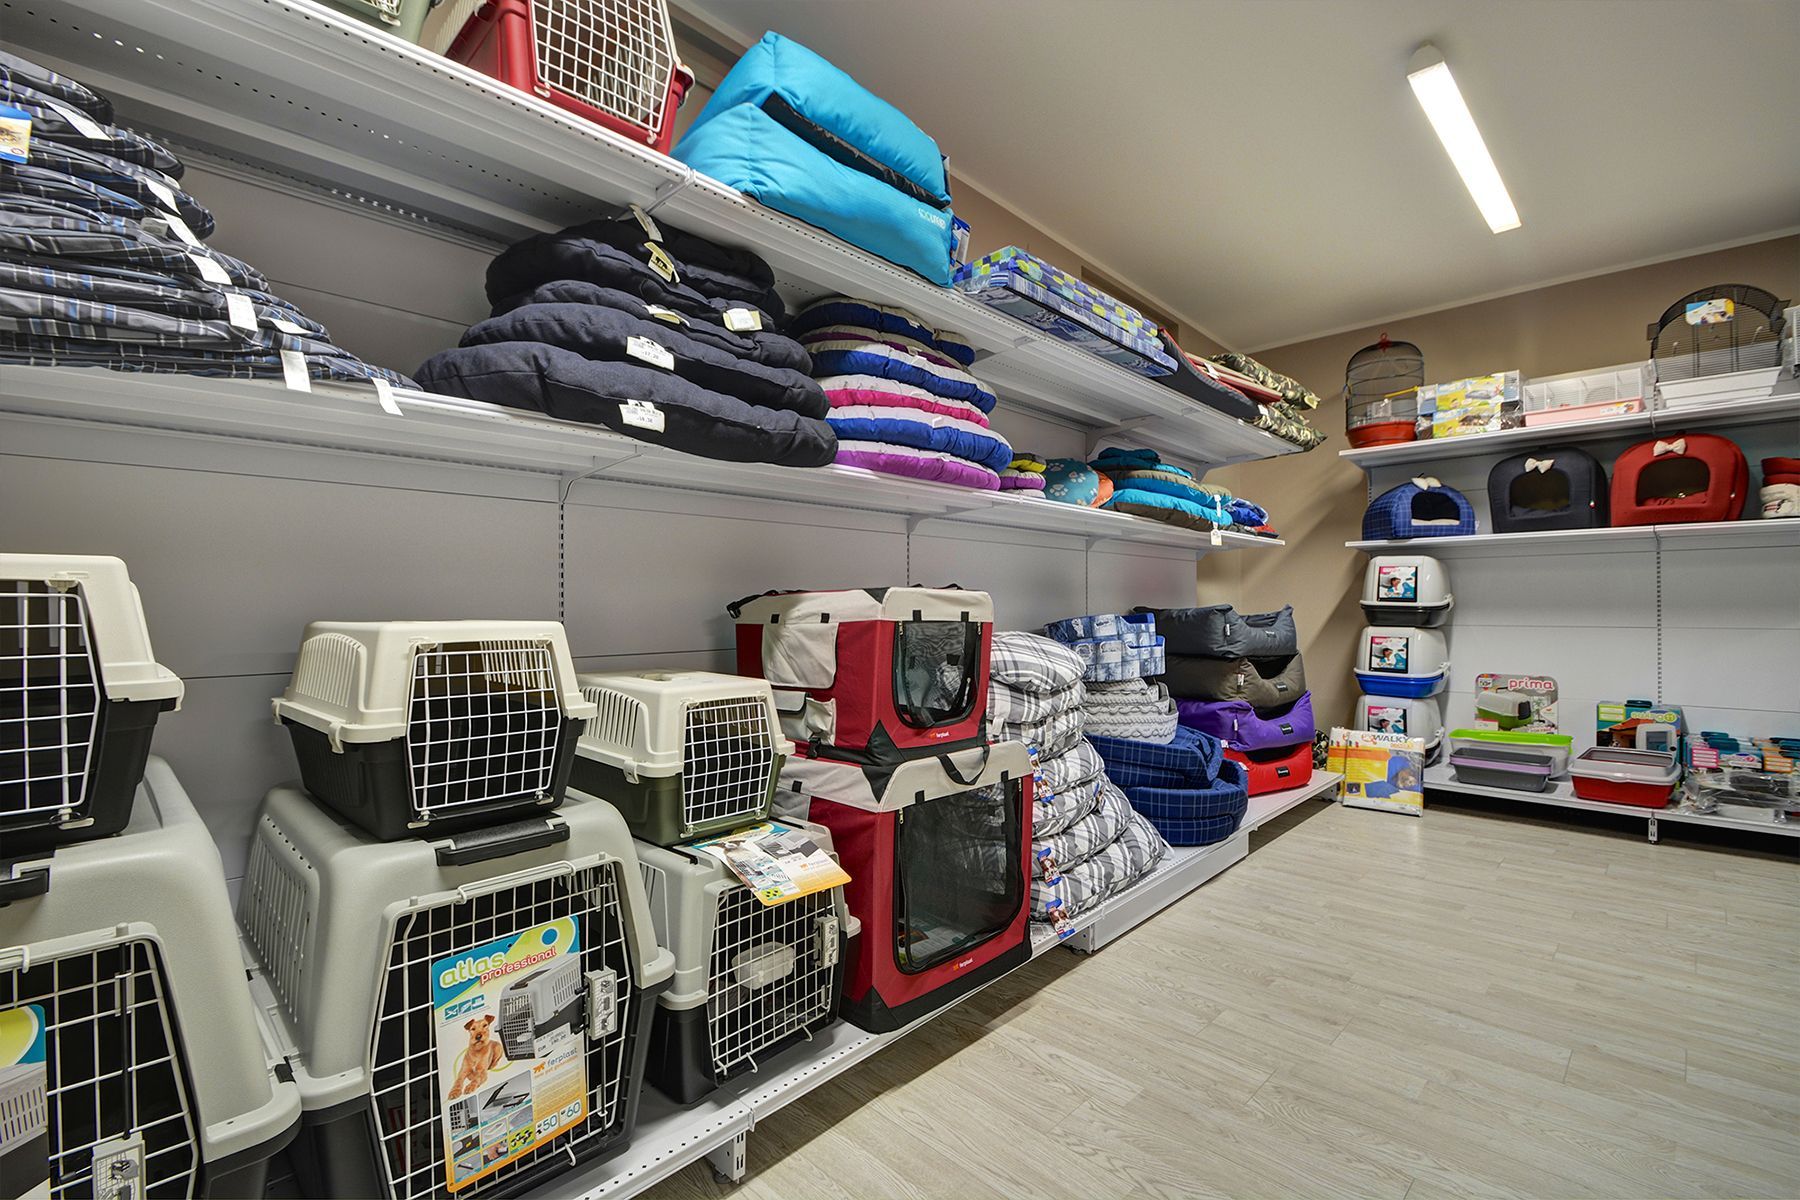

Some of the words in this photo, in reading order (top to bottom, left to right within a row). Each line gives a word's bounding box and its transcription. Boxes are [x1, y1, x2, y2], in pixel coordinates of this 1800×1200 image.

[1508, 677, 1555, 691] prima
[440, 952, 505, 988] atlas
[480, 946, 557, 986] professional
[547, 1047, 578, 1067] ferplast
[567, 1101, 581, 1118] 60
[543, 1114, 558, 1132] 50
